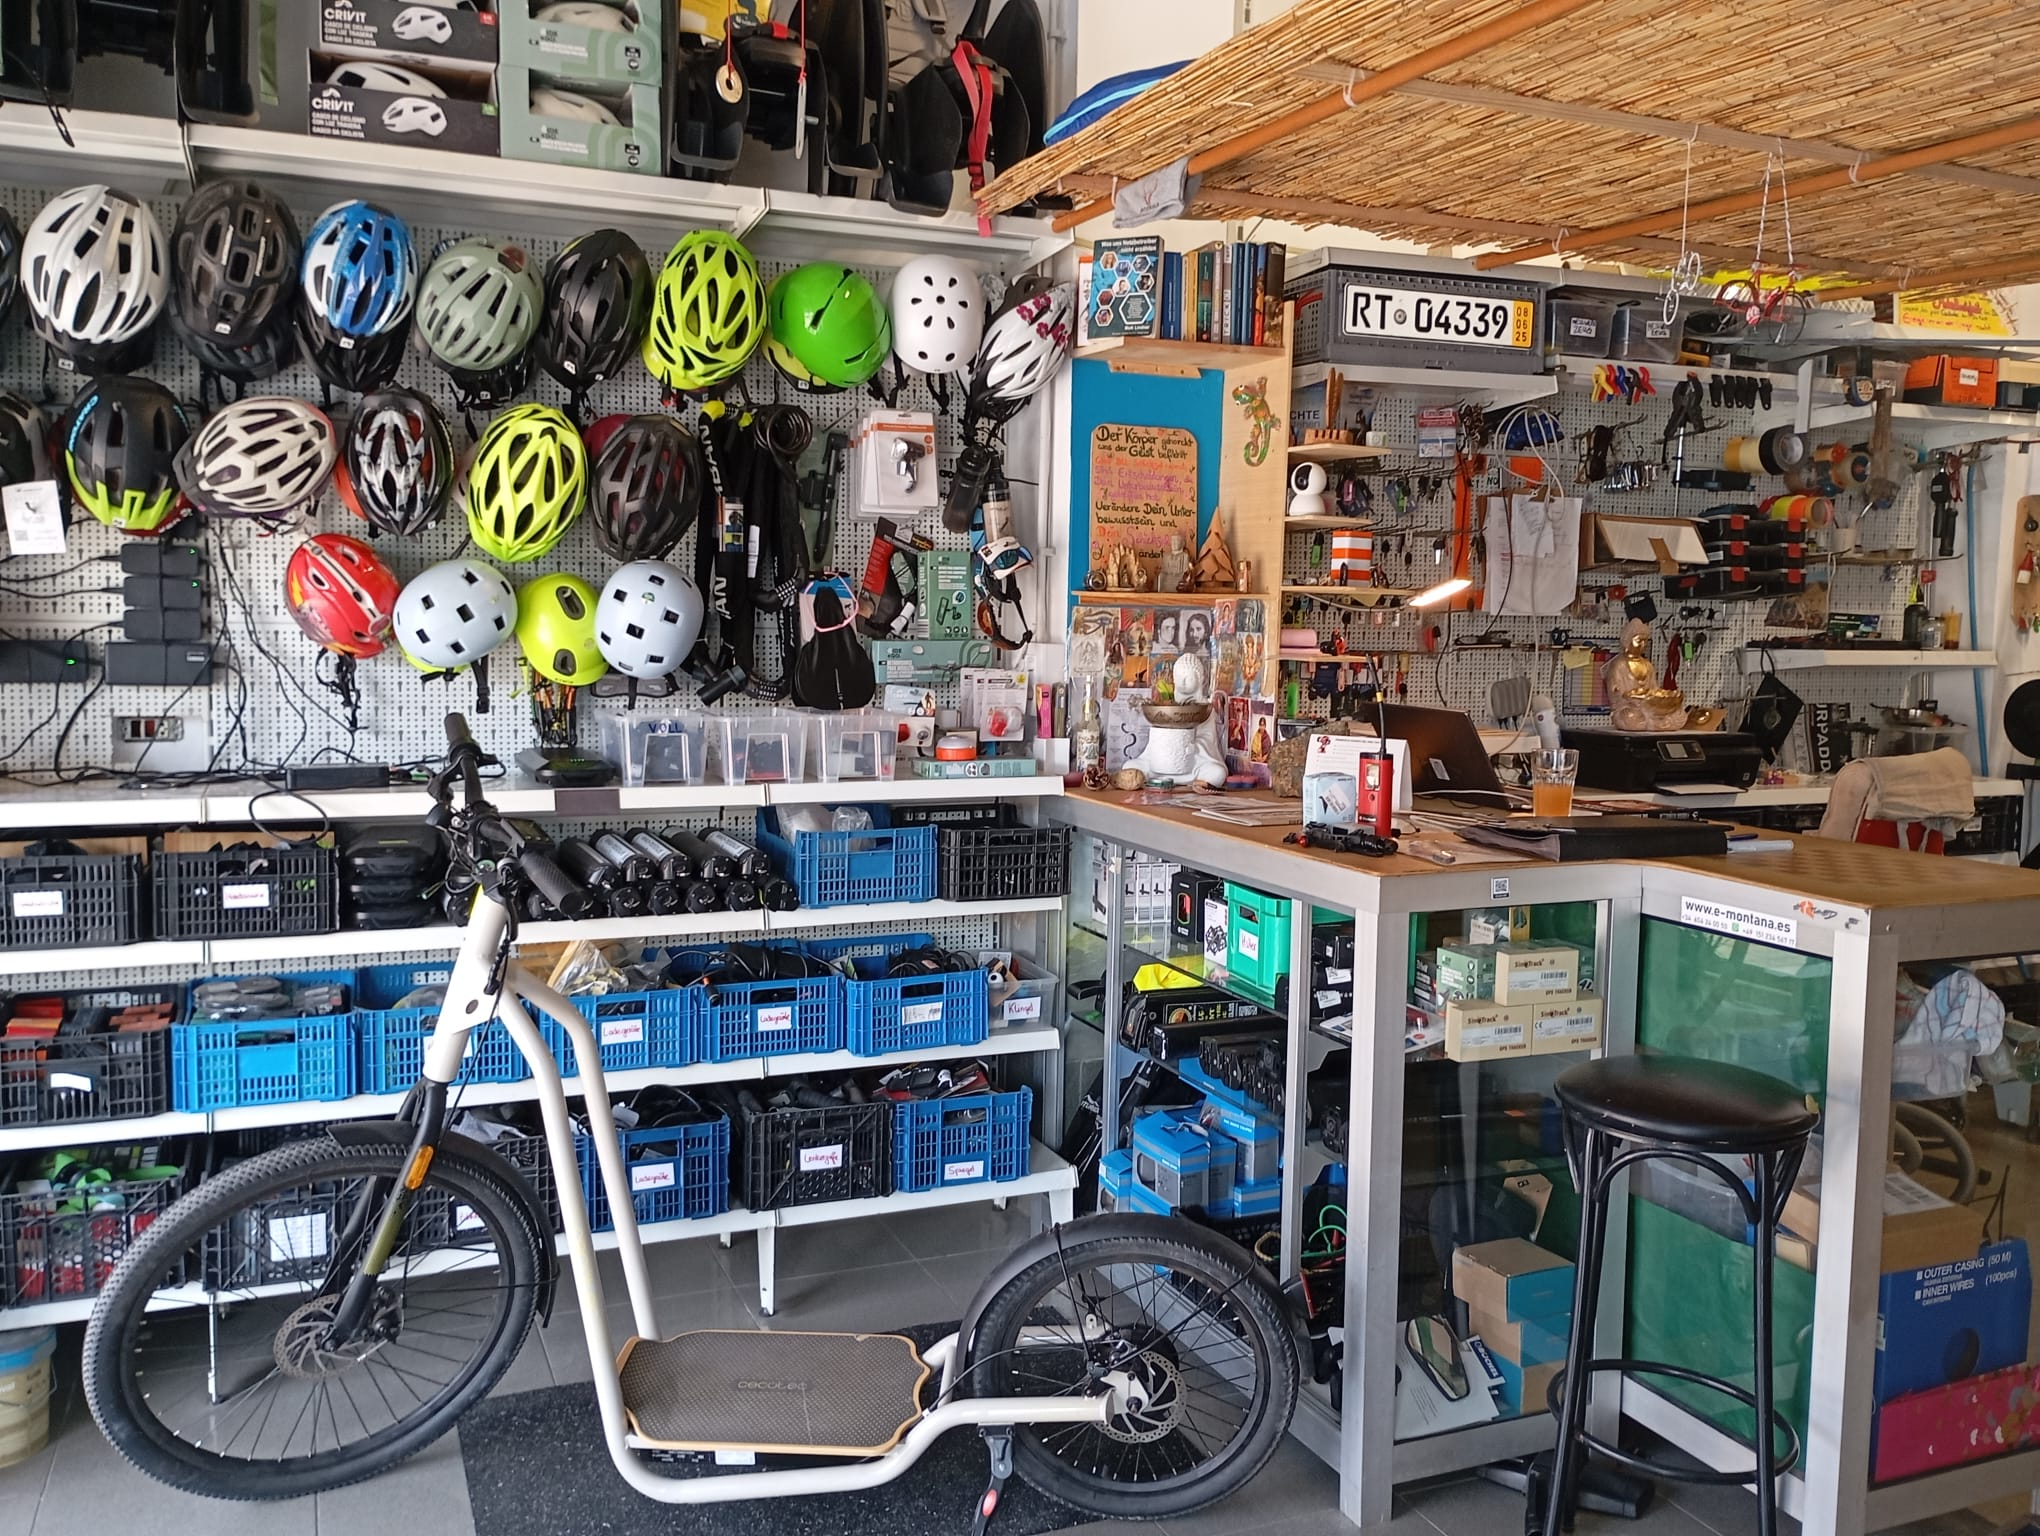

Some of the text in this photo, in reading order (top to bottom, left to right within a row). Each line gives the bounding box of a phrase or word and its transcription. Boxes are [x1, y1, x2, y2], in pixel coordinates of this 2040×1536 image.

[324, 8, 367, 23] CRIVIT
[311, 97, 354, 112] CRIVIT
[1352, 292, 1508, 339] RT 04339
[1516, 306, 1529, 318] 08
[1515, 319, 1528, 330] 06
[1515, 331, 1527, 343] 25
[1096, 425, 1123, 442] Der
[1124, 427, 1159, 449] Körper
[1143, 502, 1167, 517] Dein
[1160, 519, 1178, 528] und
[648, 719, 683, 734] VOLL
[1685, 901, 1791, 933] www.e-montana.es
[1924, 1265, 1953, 1280] OUTER
[1954, 1257, 1984, 1273] CASING
[1922, 1268, 2018, 1299] INNER WIRES (100pcs)
